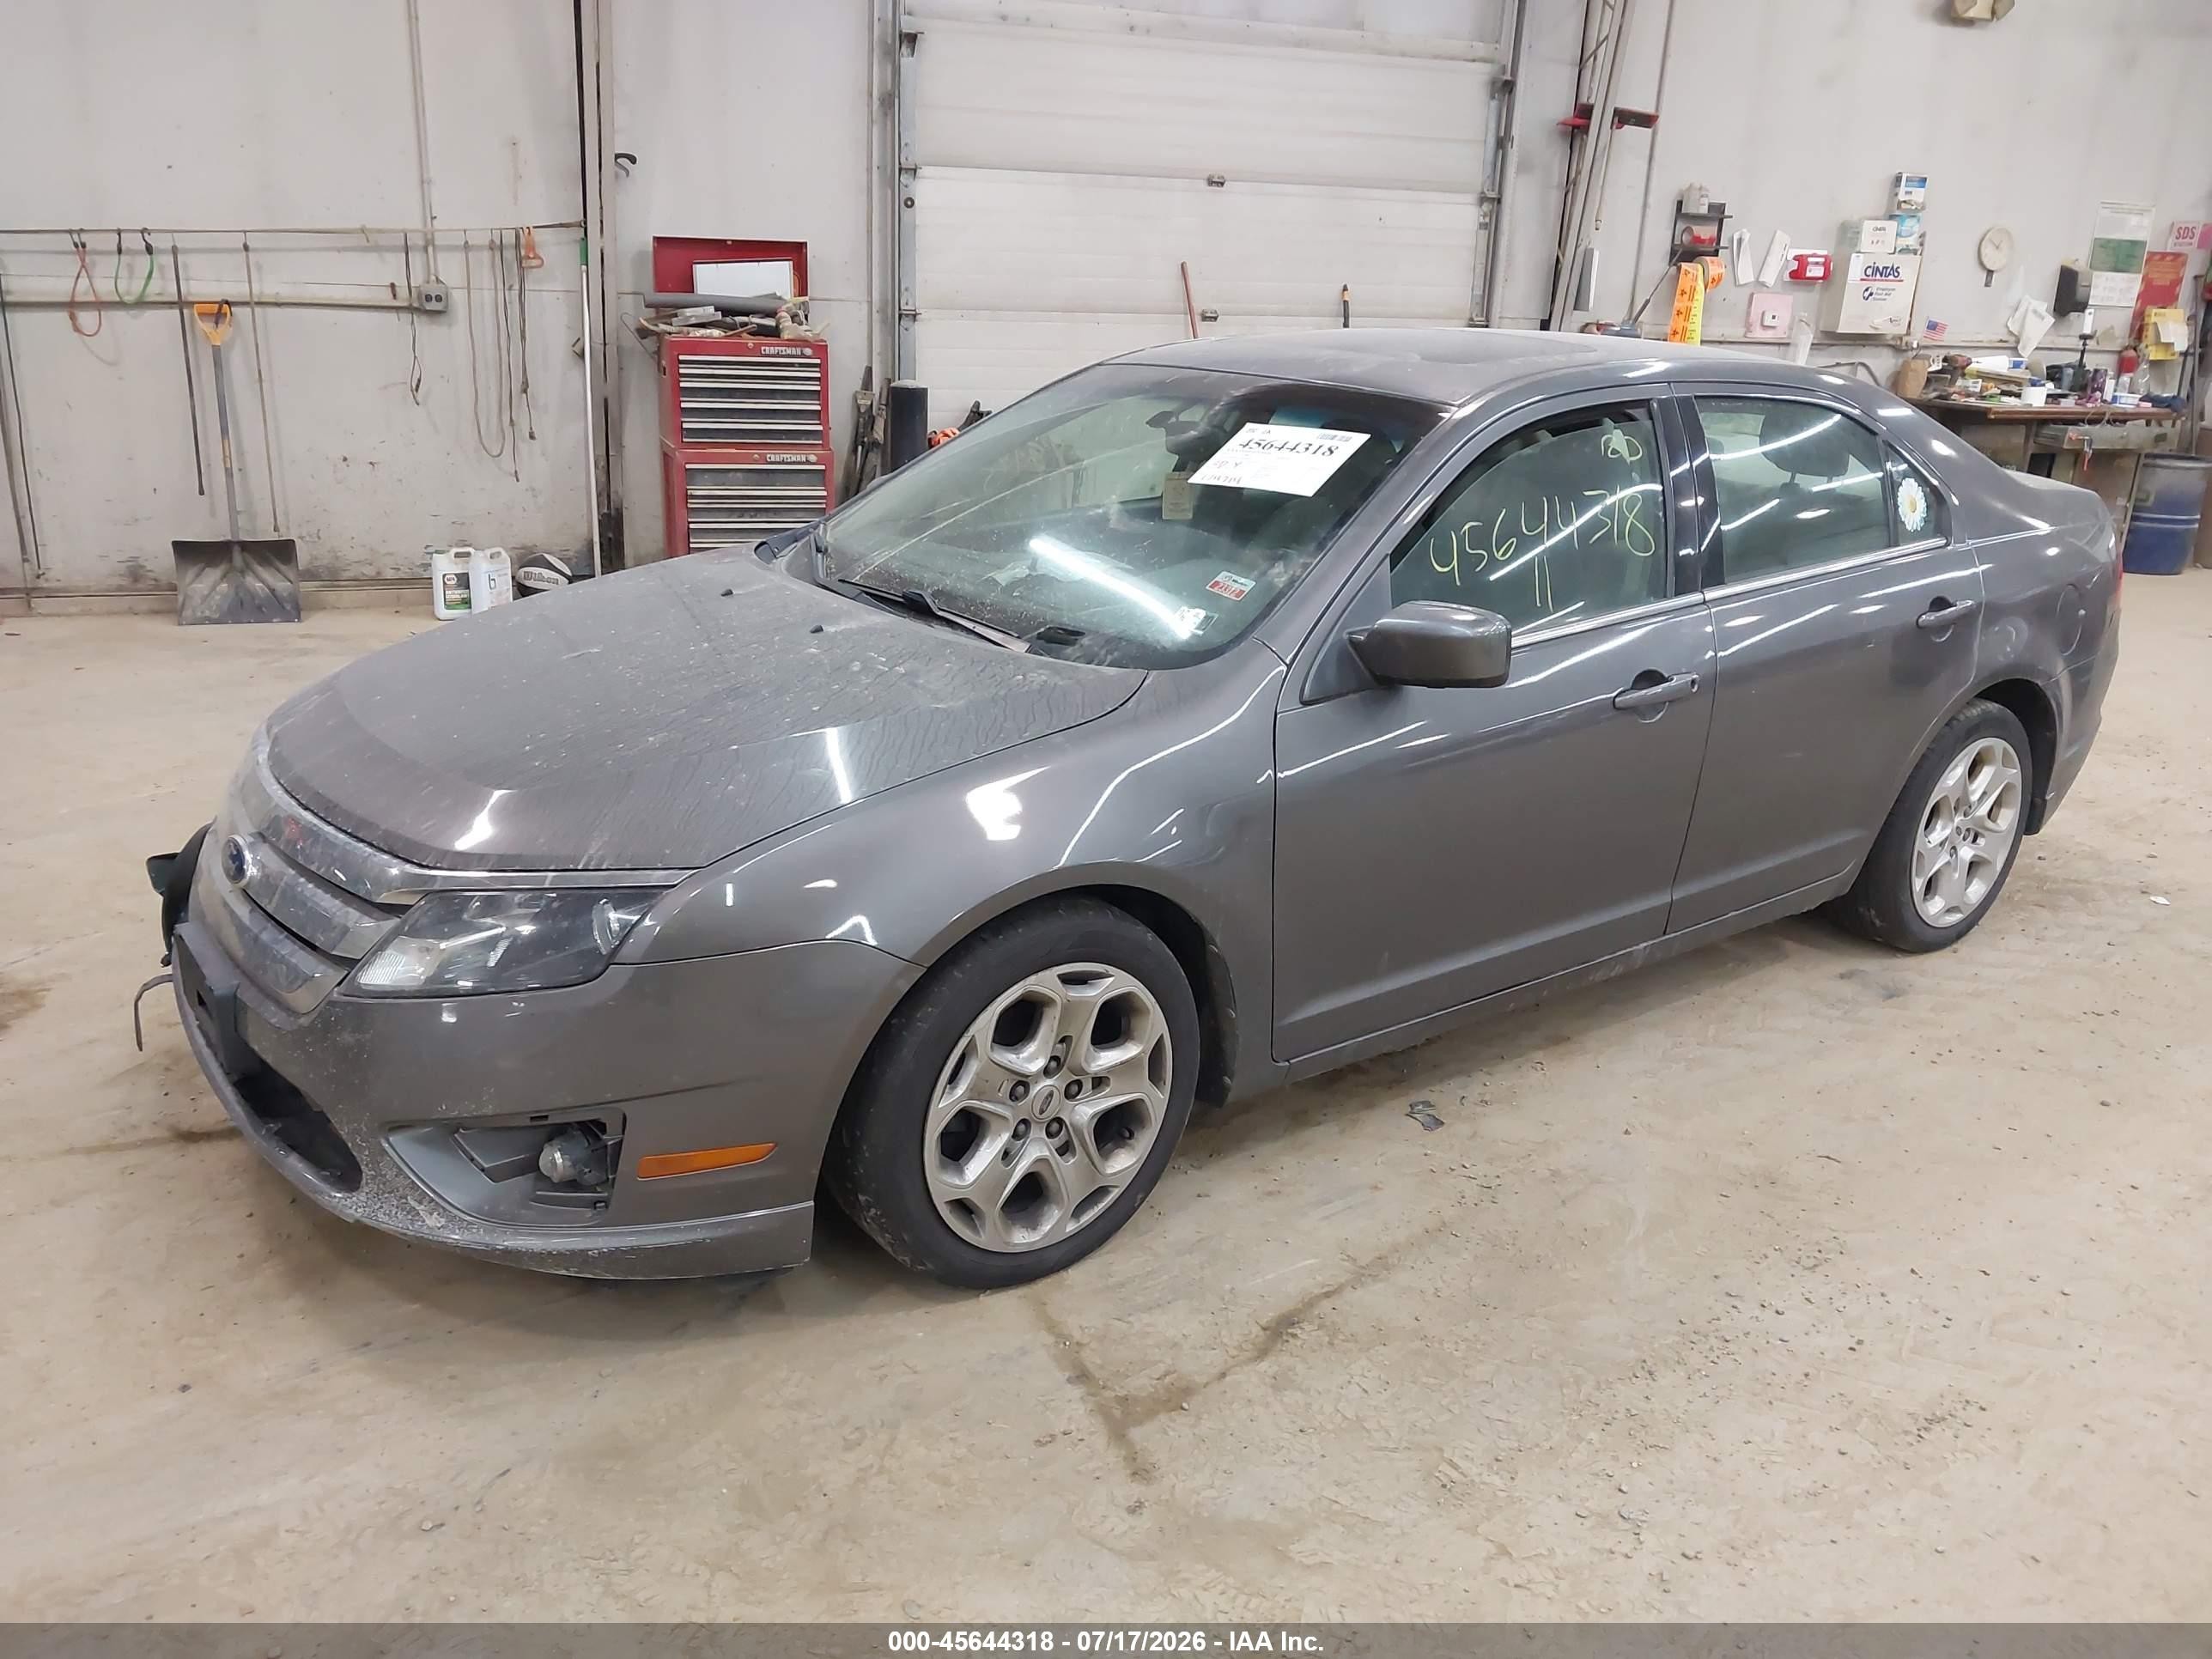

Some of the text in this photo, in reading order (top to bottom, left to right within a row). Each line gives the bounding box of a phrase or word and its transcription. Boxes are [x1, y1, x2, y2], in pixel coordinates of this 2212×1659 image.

[2175, 226, 2197, 240] SDS
[1864, 261, 1900, 278] CINTAS
[761, 346, 801, 356] CRAFTSMAN
[1238, 438, 1339, 457] 45644318
[766, 453, 806, 463] CRAFTSMAN
[1429, 484, 1656, 586] 45644318
[523, 570, 559, 586] Wilson
